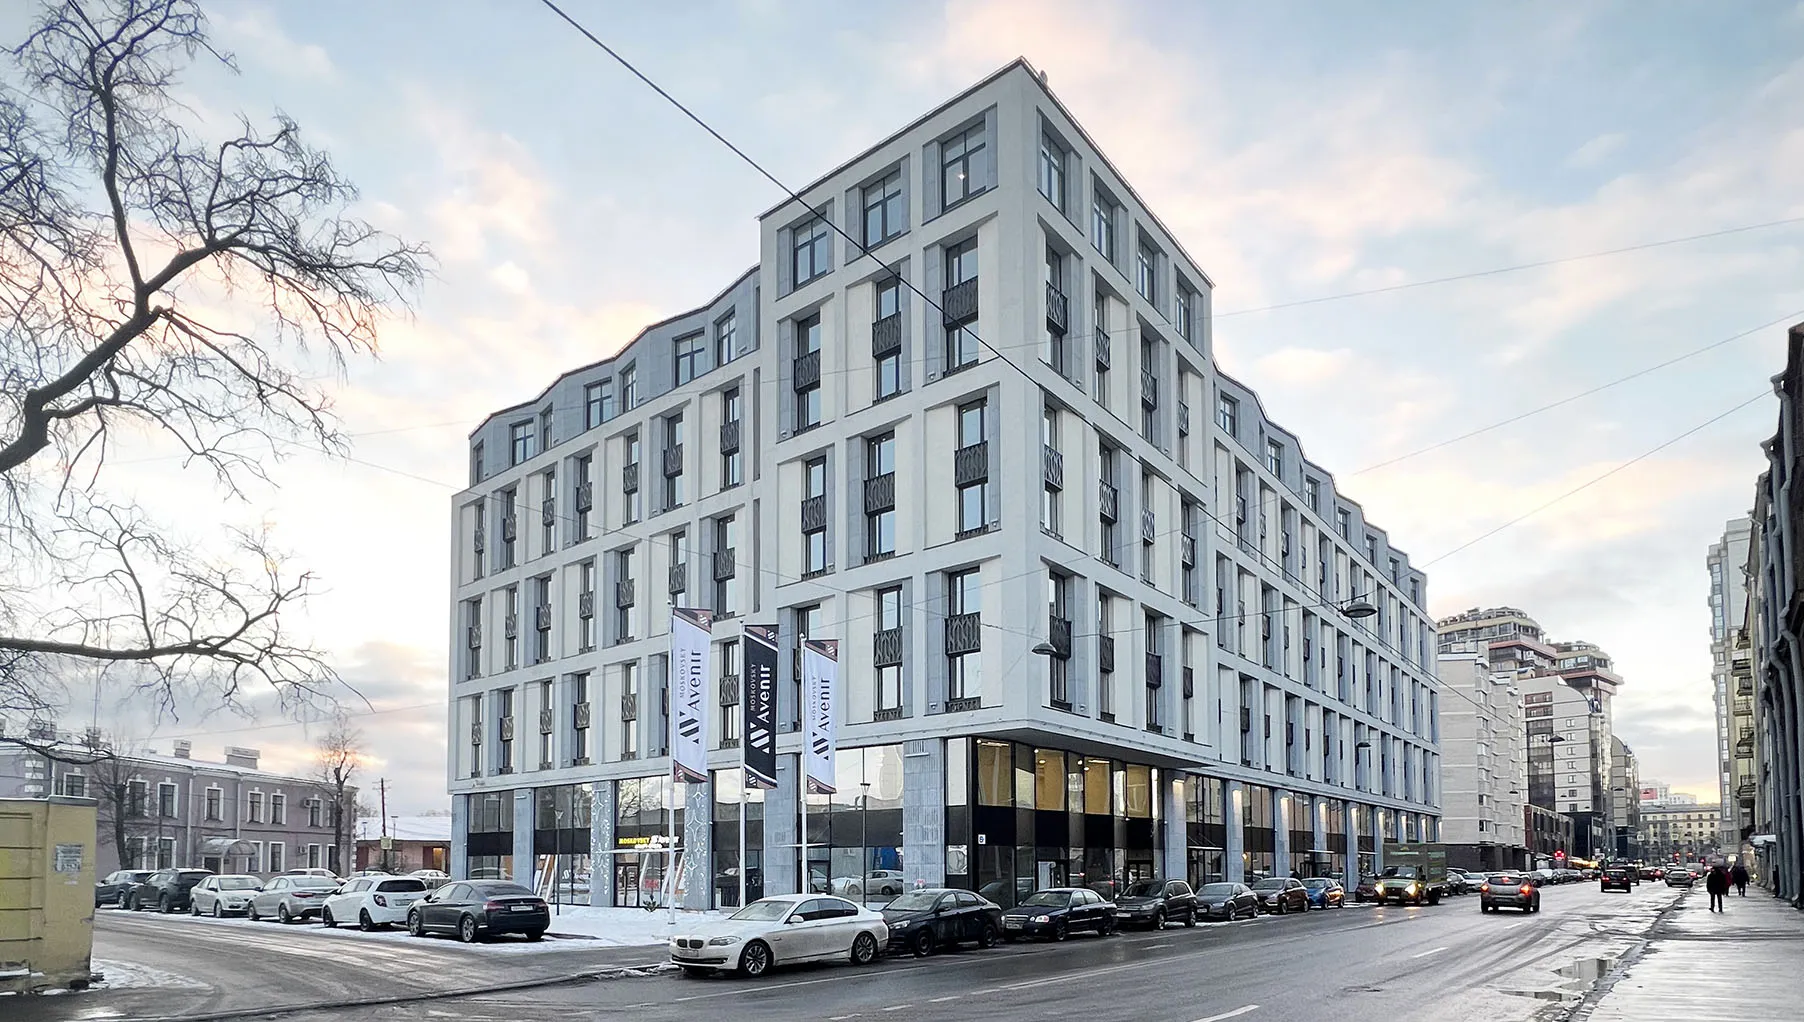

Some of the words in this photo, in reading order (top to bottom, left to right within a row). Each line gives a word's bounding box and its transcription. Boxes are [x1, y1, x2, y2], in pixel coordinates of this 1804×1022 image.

[687, 649, 701, 711] Avenir
[757, 664, 771, 724] Avenir
[818, 677, 830, 732] Avenir
